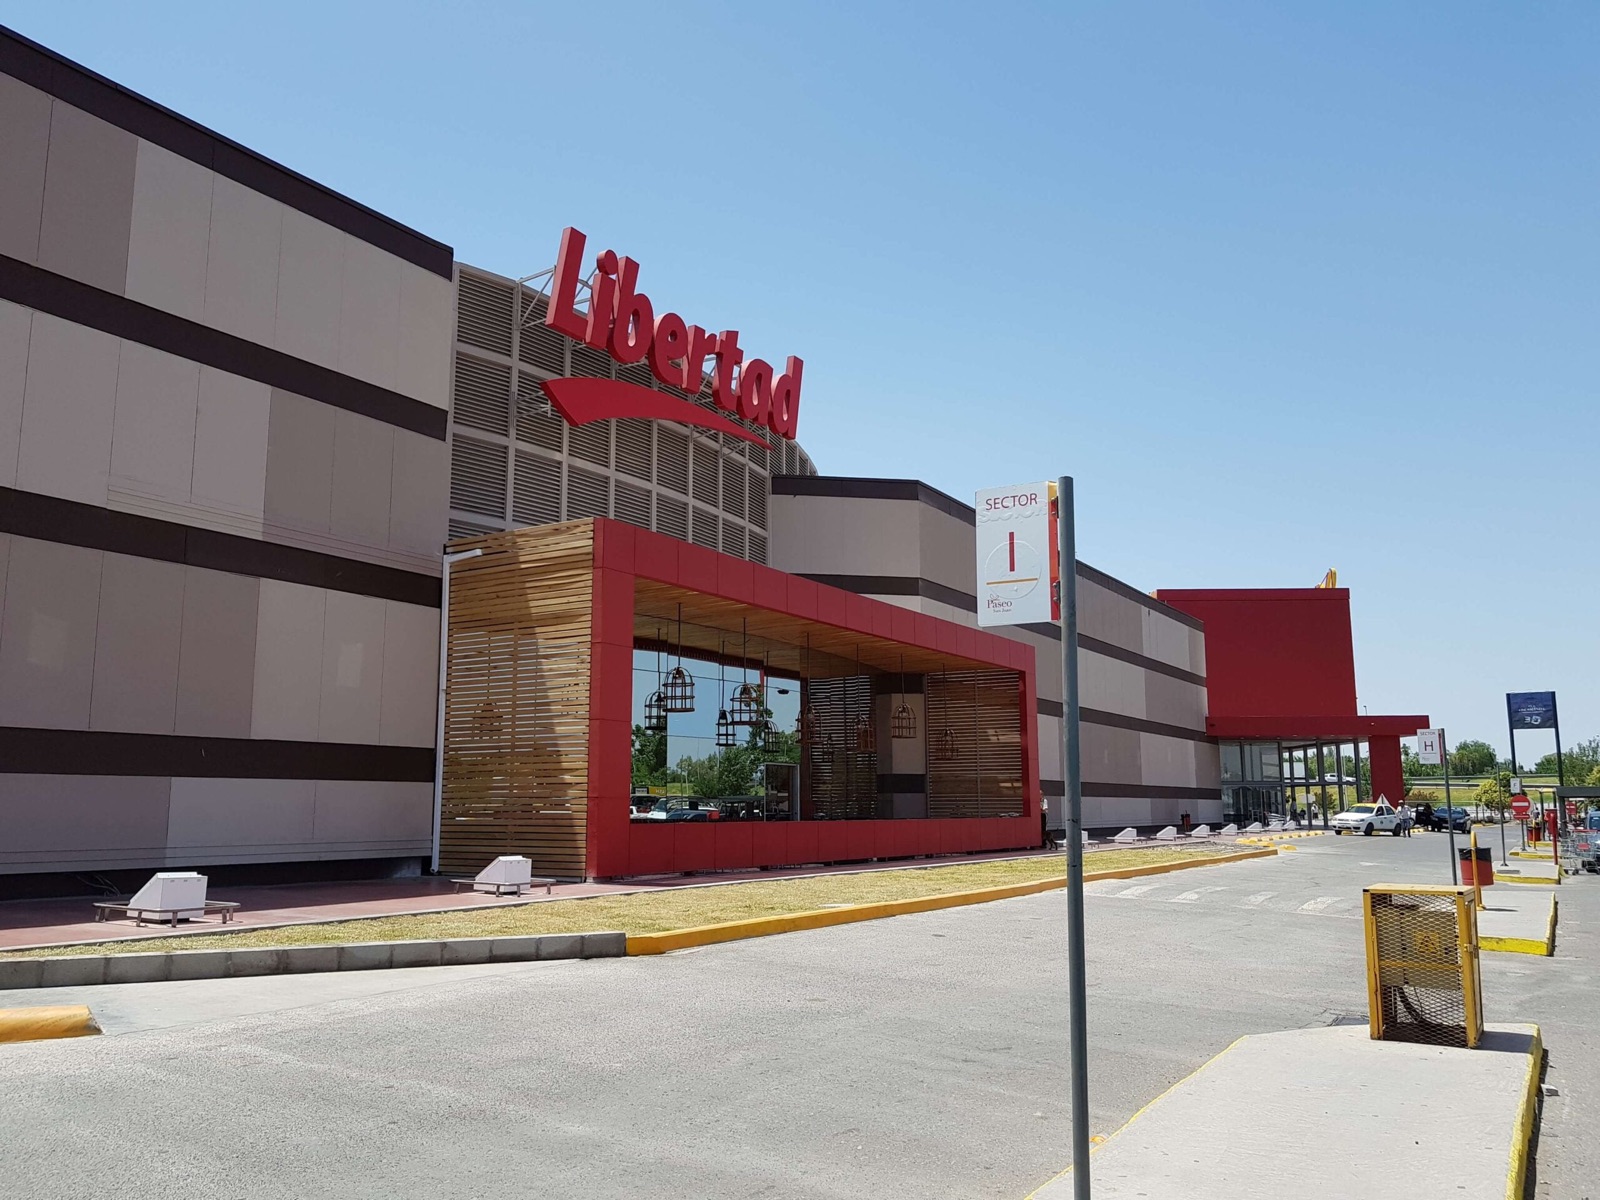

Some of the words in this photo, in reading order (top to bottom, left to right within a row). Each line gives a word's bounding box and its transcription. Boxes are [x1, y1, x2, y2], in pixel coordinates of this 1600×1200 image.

[545, 226, 804, 440] Libertad
[986, 493, 1038, 510] SECTOR
[1009, 532, 1015, 572] I
[987, 599, 1013, 609] Paseo
[1424, 741, 1434, 751] H
